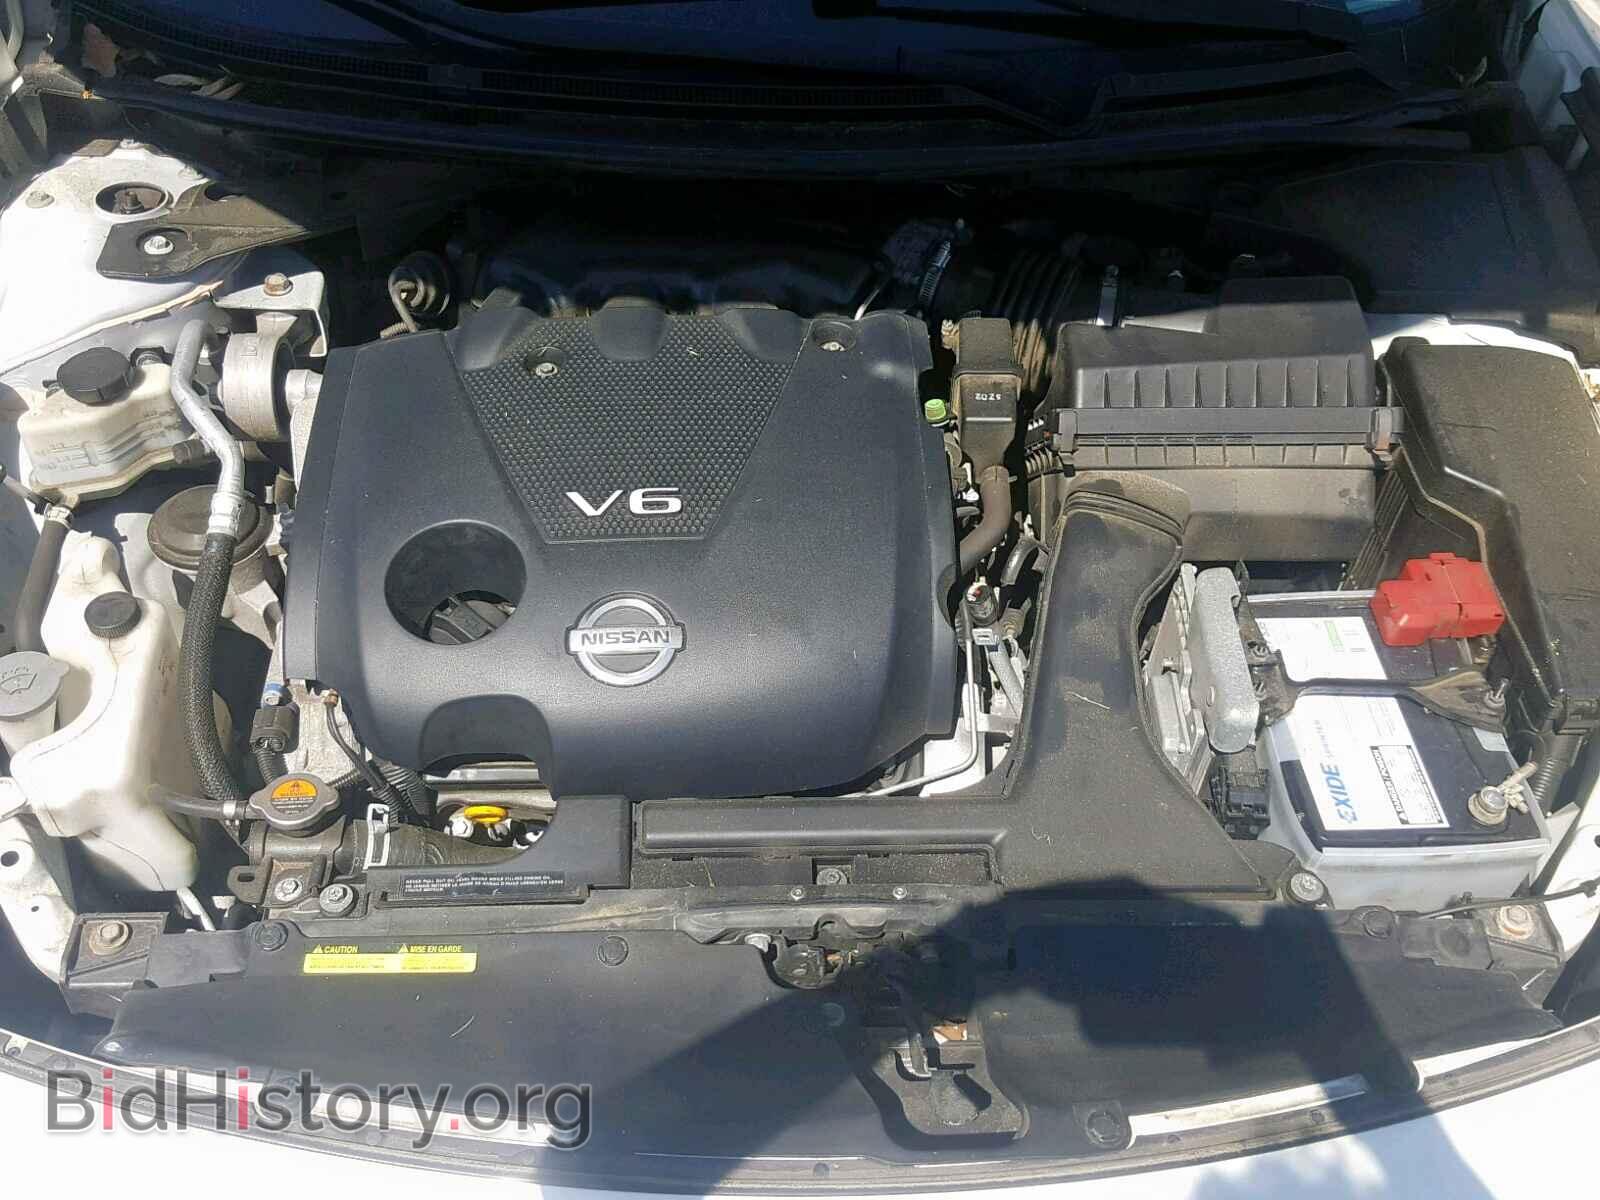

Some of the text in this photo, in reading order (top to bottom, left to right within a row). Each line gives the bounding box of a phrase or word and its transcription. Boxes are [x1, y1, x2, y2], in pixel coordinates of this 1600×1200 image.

[565, 487, 682, 516] V6
[581, 630, 670, 646] NISSAN
[1319, 763, 1358, 823] EXIDE
[323, 945, 359, 953] CAUTION
[438, 945, 462, 953] GARDE
